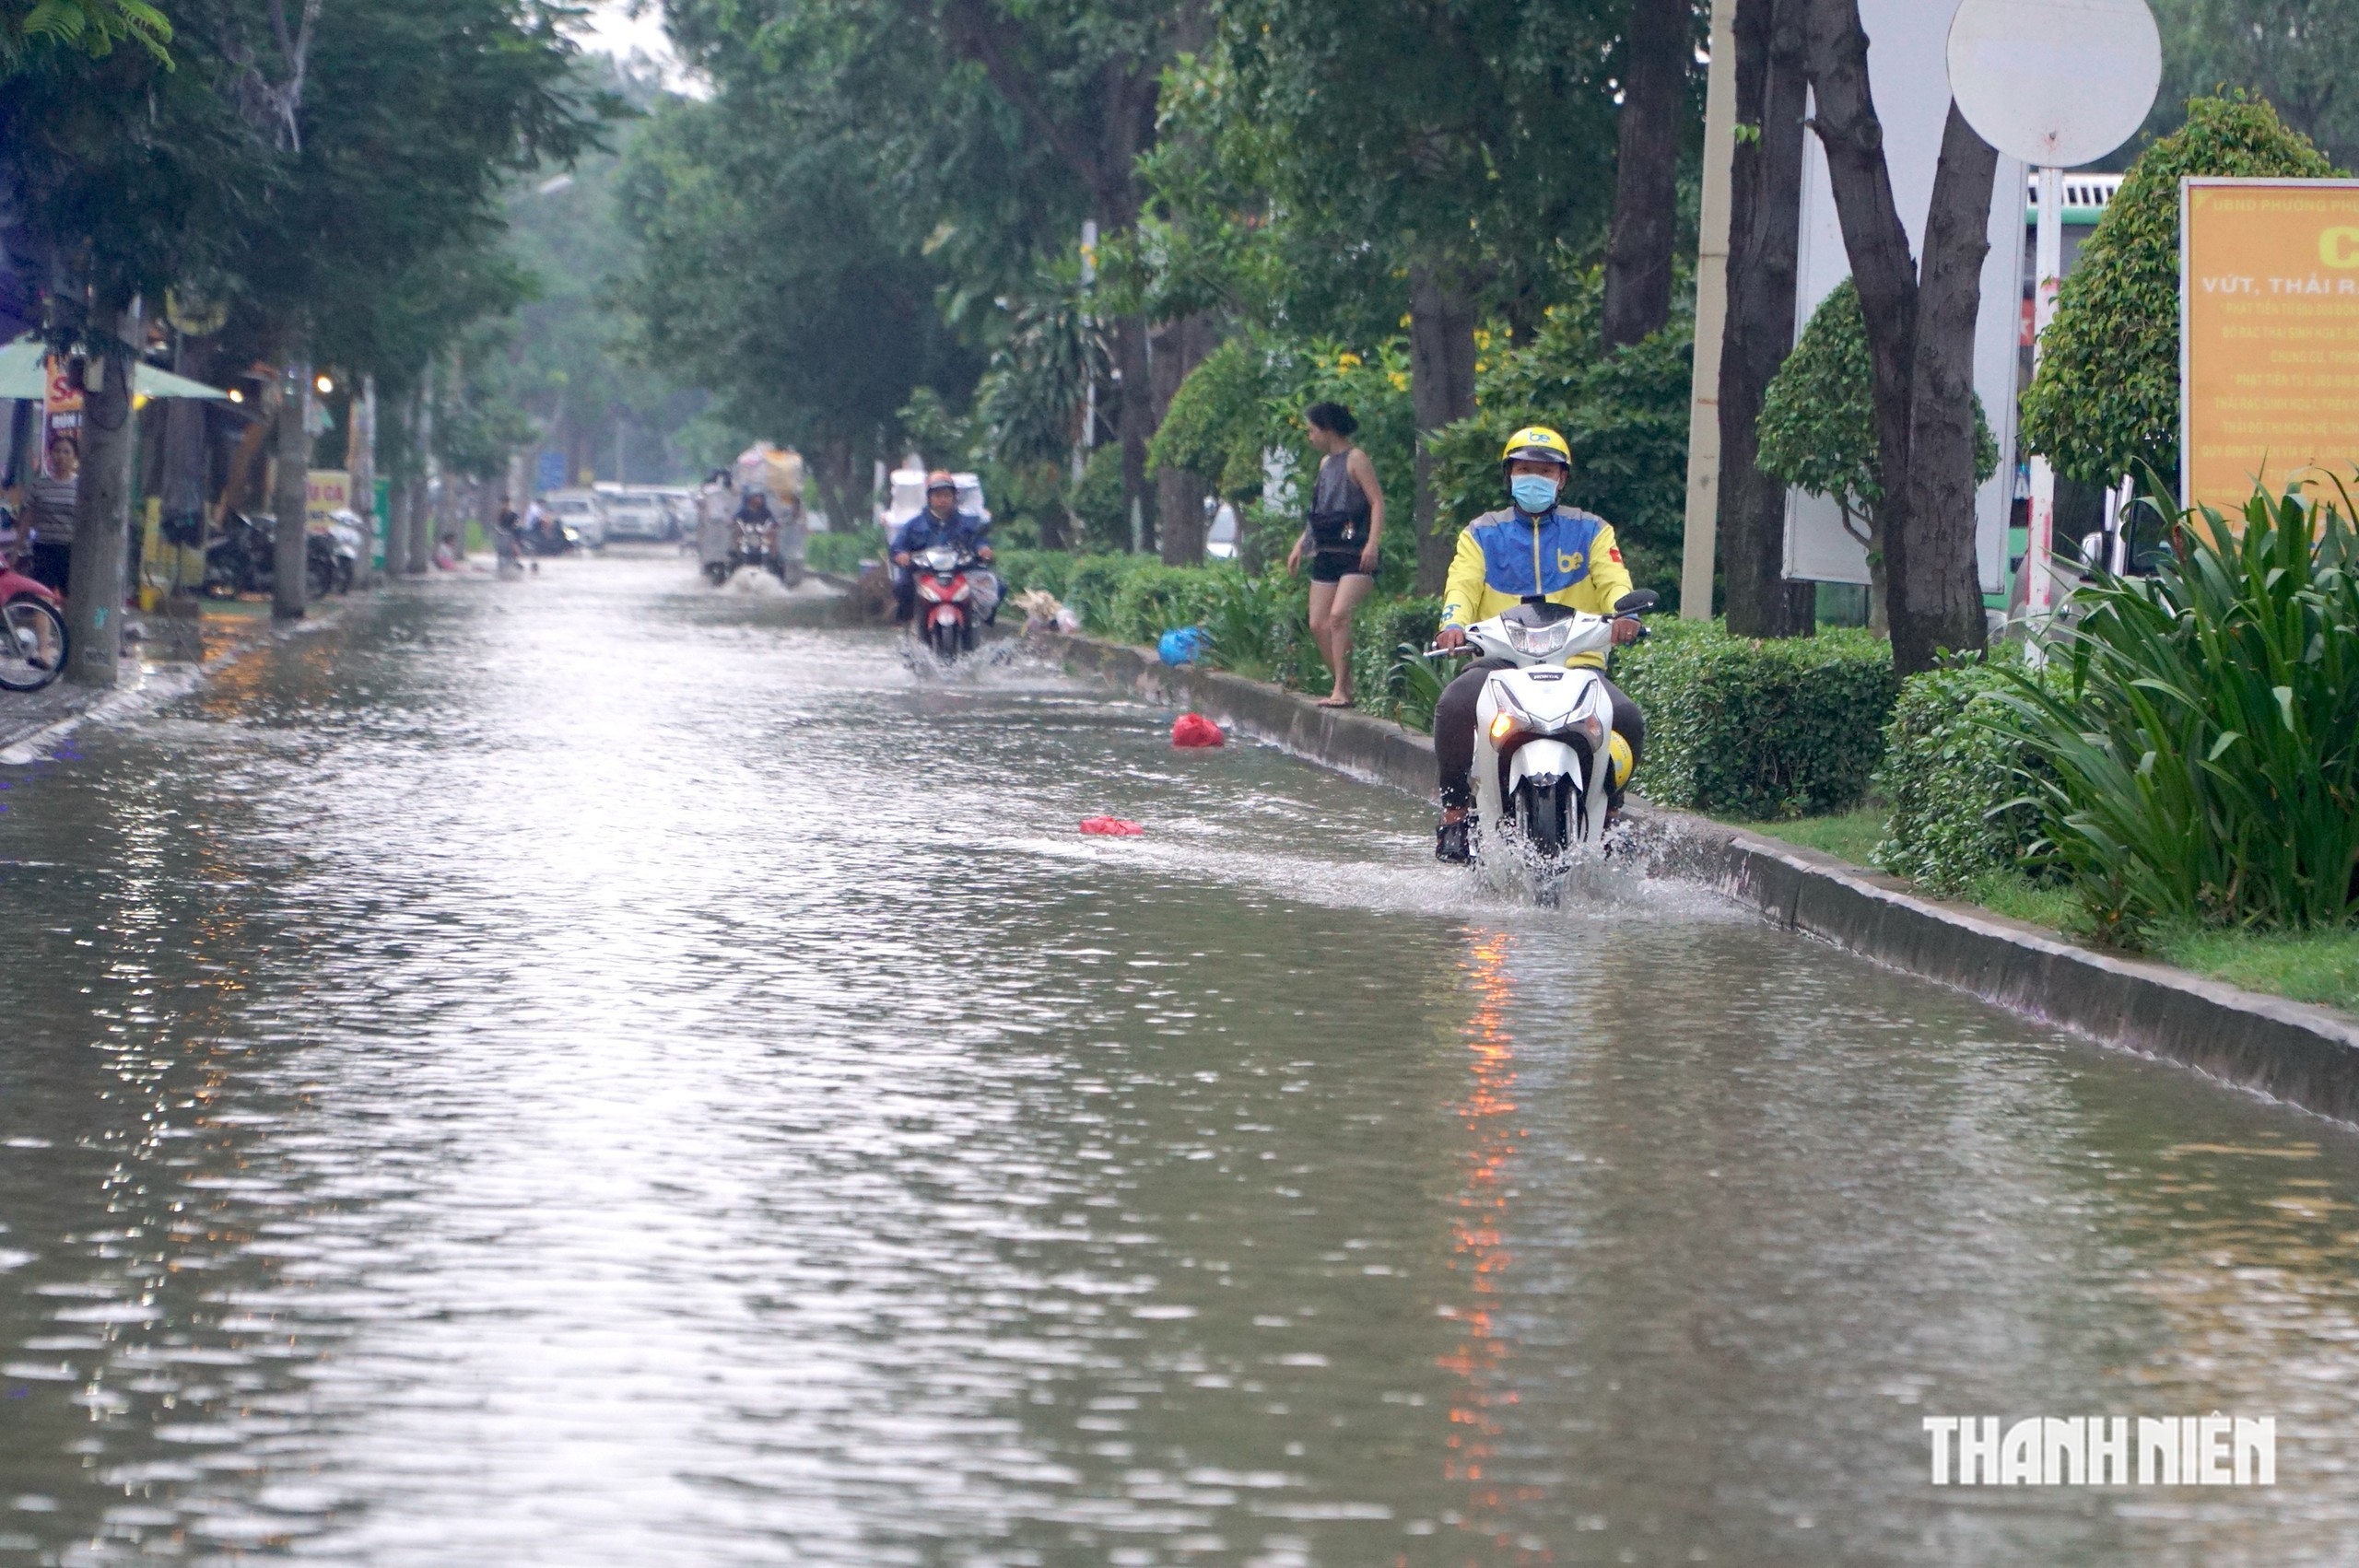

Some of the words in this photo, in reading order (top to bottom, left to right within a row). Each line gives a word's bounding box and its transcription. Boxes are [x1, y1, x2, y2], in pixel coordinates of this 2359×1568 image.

[2269, 272, 2330, 294] THẢI
[2338, 279, 2359, 295] R
[1529, 431, 1550, 443] be
[1557, 547, 1584, 573] be
